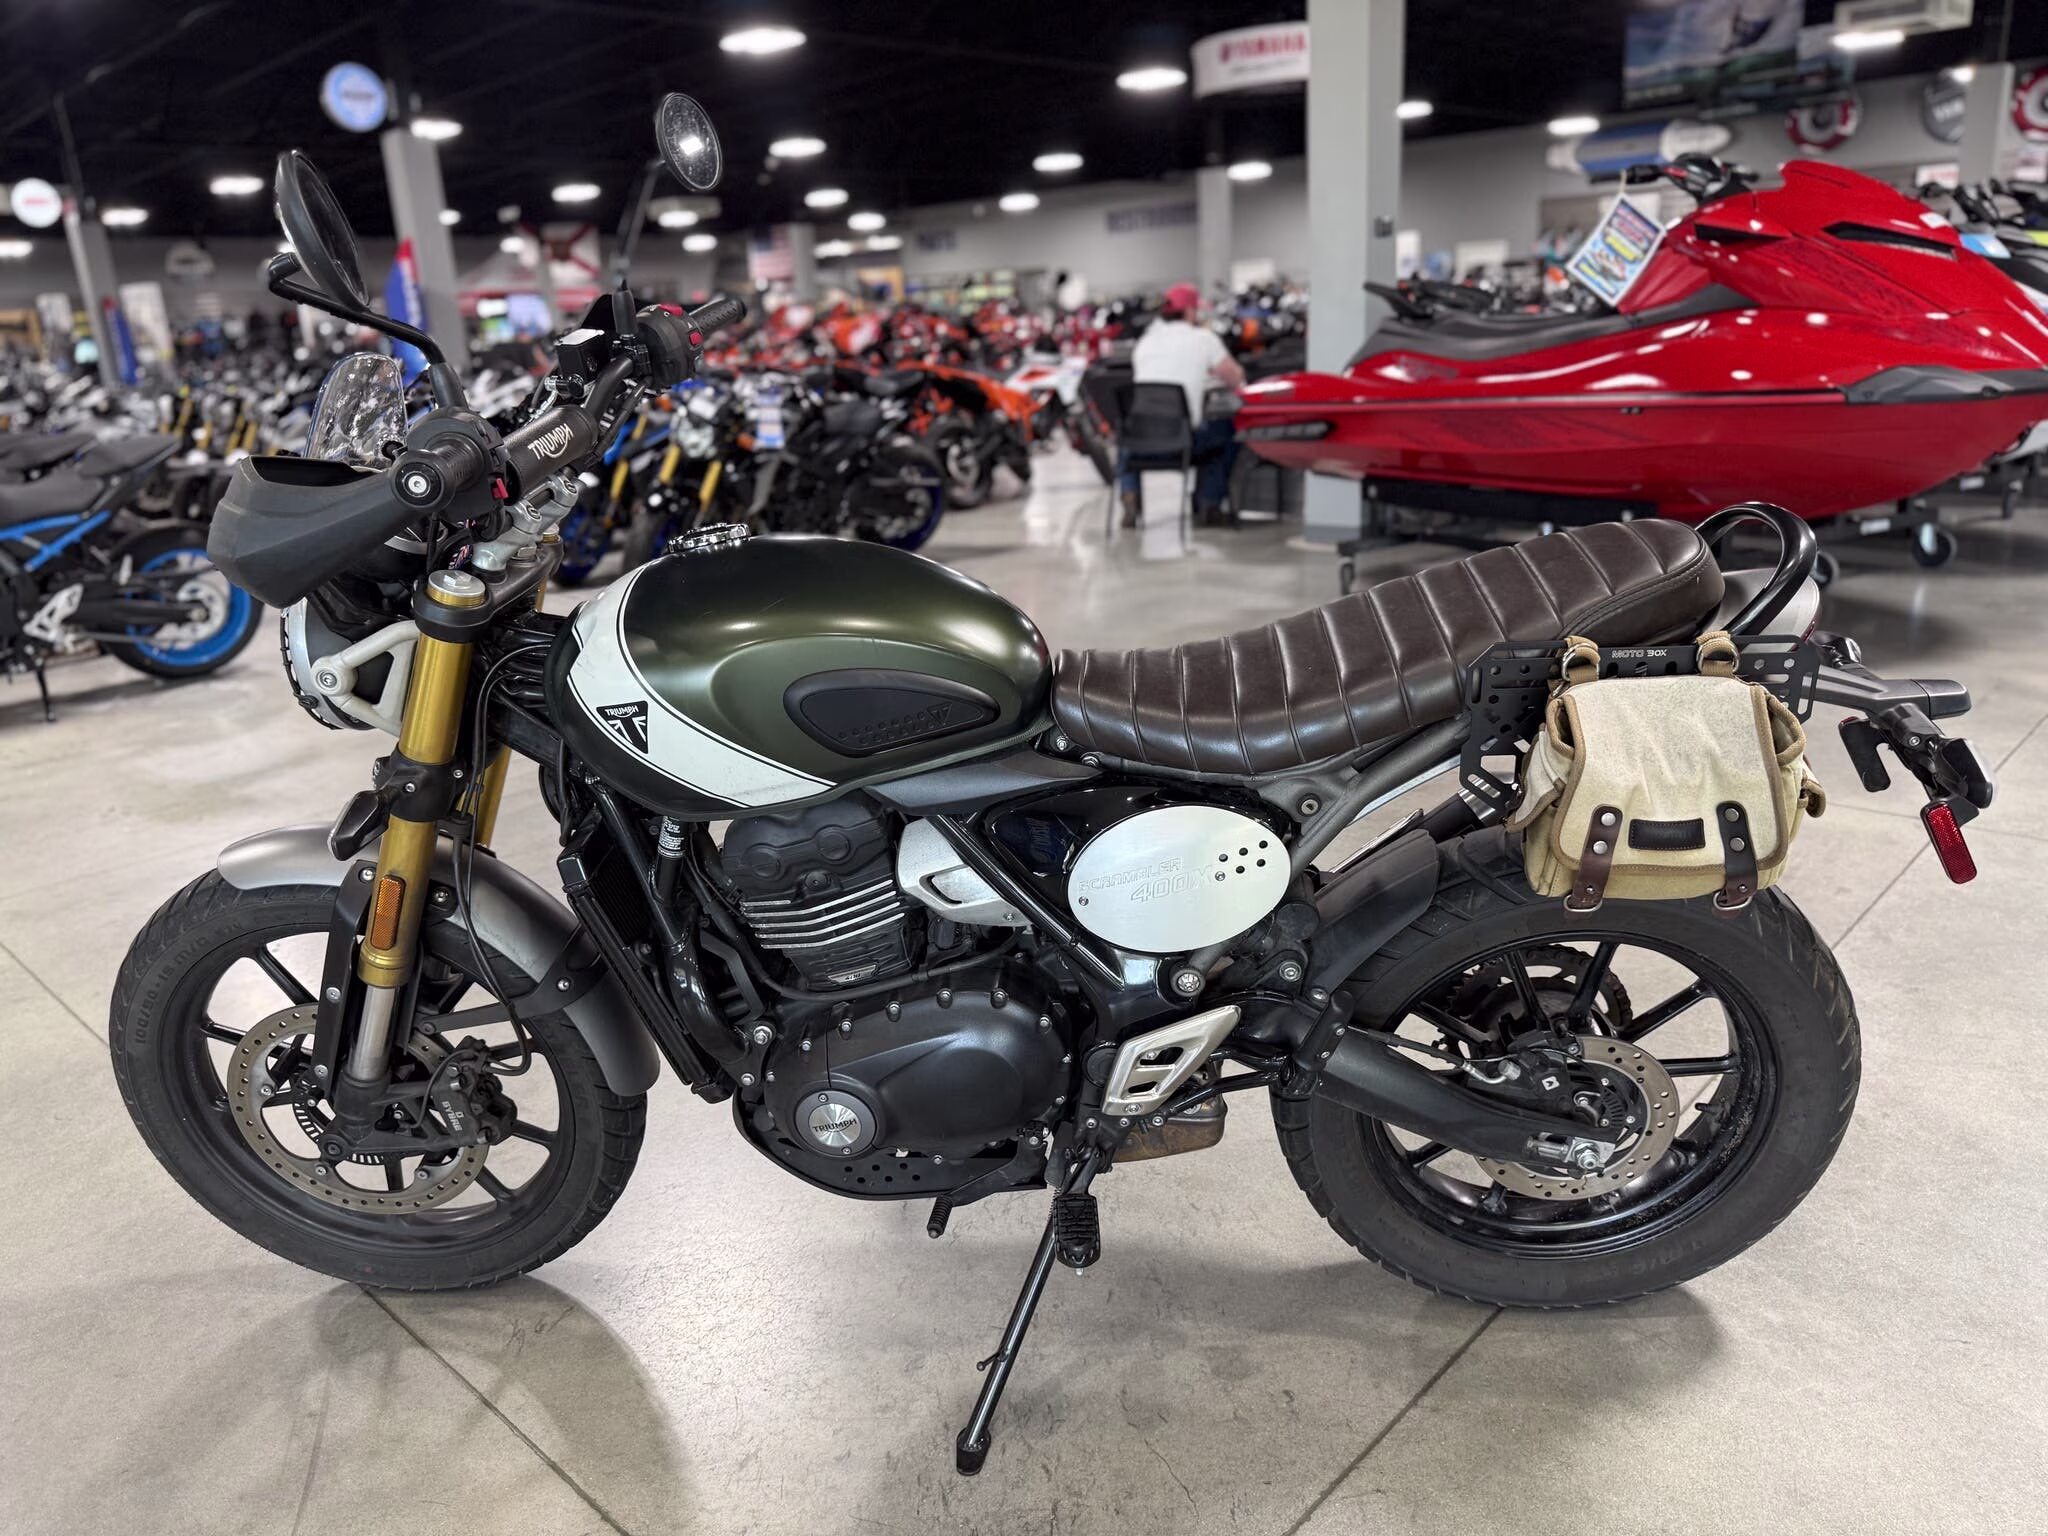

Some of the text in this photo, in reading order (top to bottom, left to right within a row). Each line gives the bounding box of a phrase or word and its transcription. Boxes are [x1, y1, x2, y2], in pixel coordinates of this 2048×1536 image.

[527, 423, 574, 460] TRIUMPH
[1611, 649, 1668, 659] MOTO BOX
[604, 705, 639, 718] TRIUMPH
[1078, 858, 1181, 893] SCRAMBLER
[1131, 864, 1213, 902] 400X
[812, 1118, 857, 1133] TRIUMPH
